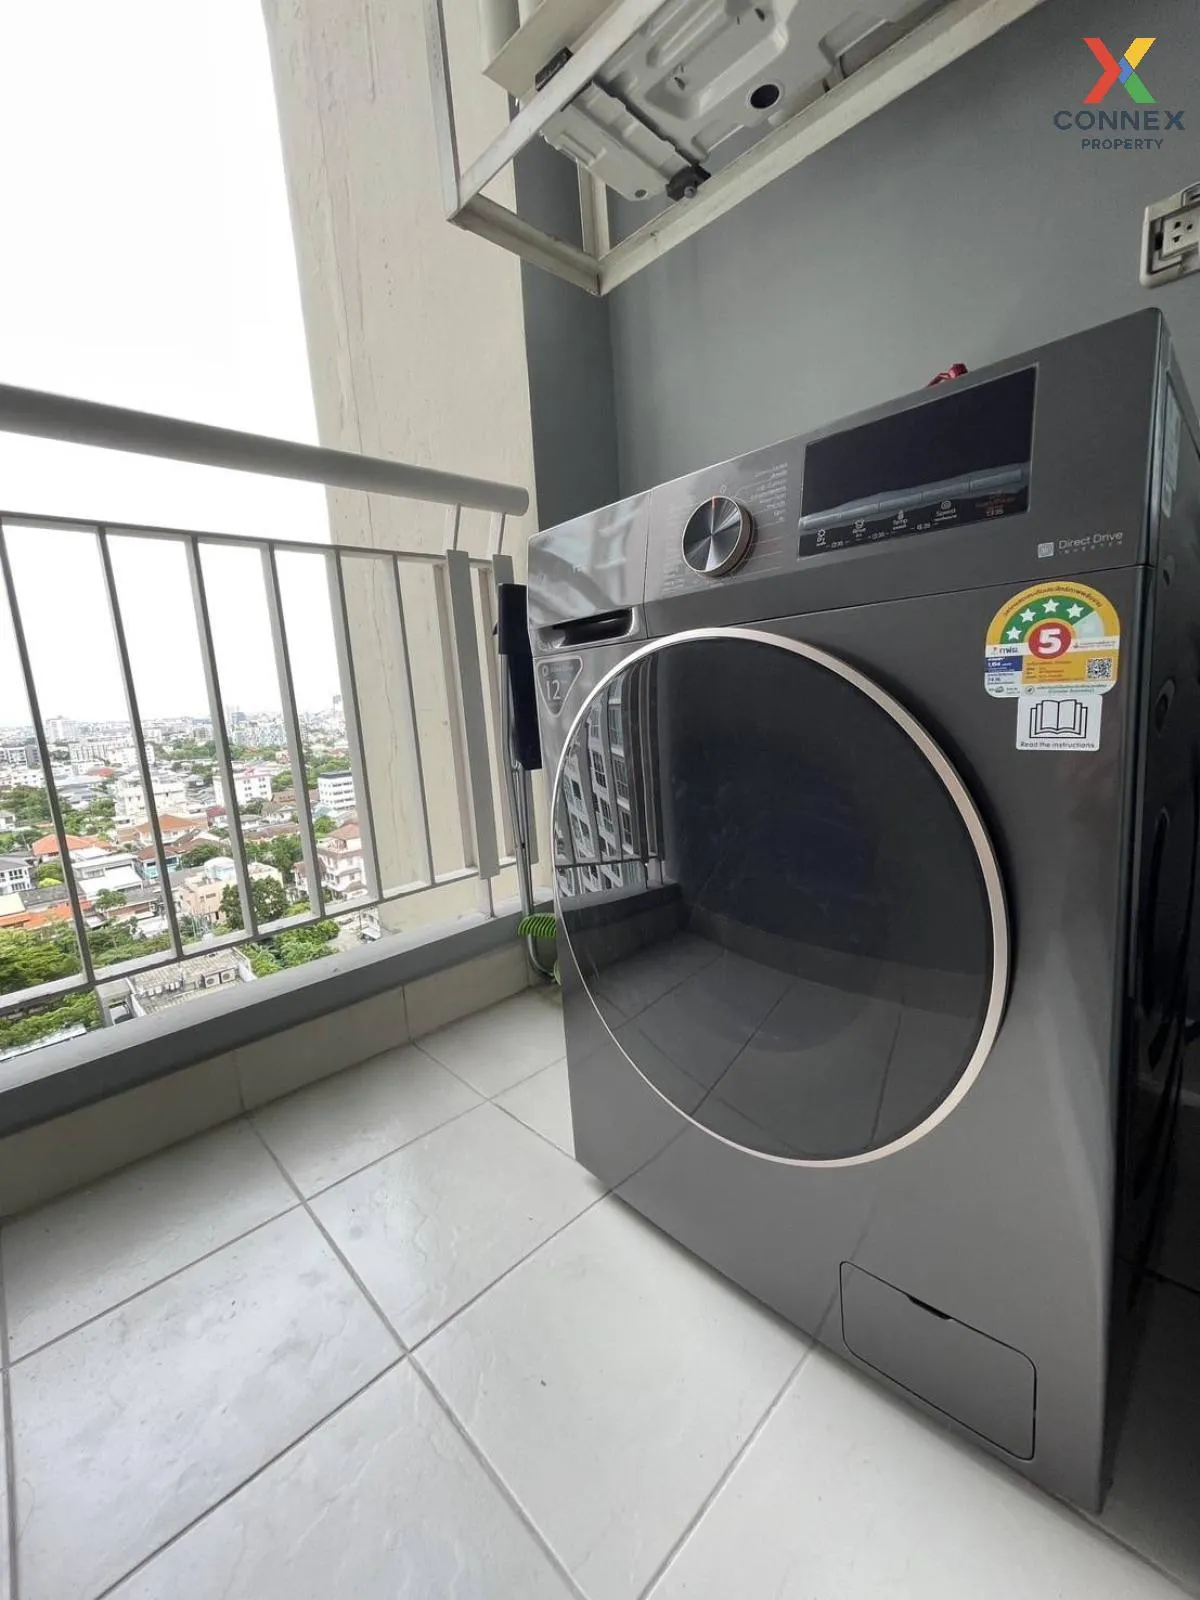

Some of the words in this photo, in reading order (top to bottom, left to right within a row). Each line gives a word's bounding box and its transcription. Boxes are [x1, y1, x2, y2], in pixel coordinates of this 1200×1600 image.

[1058, 536, 1090, 549] Direct
[1093, 531, 1124, 544] Drive
[1038, 628, 1062, 654] 5
[545, 679, 561, 701] 12
